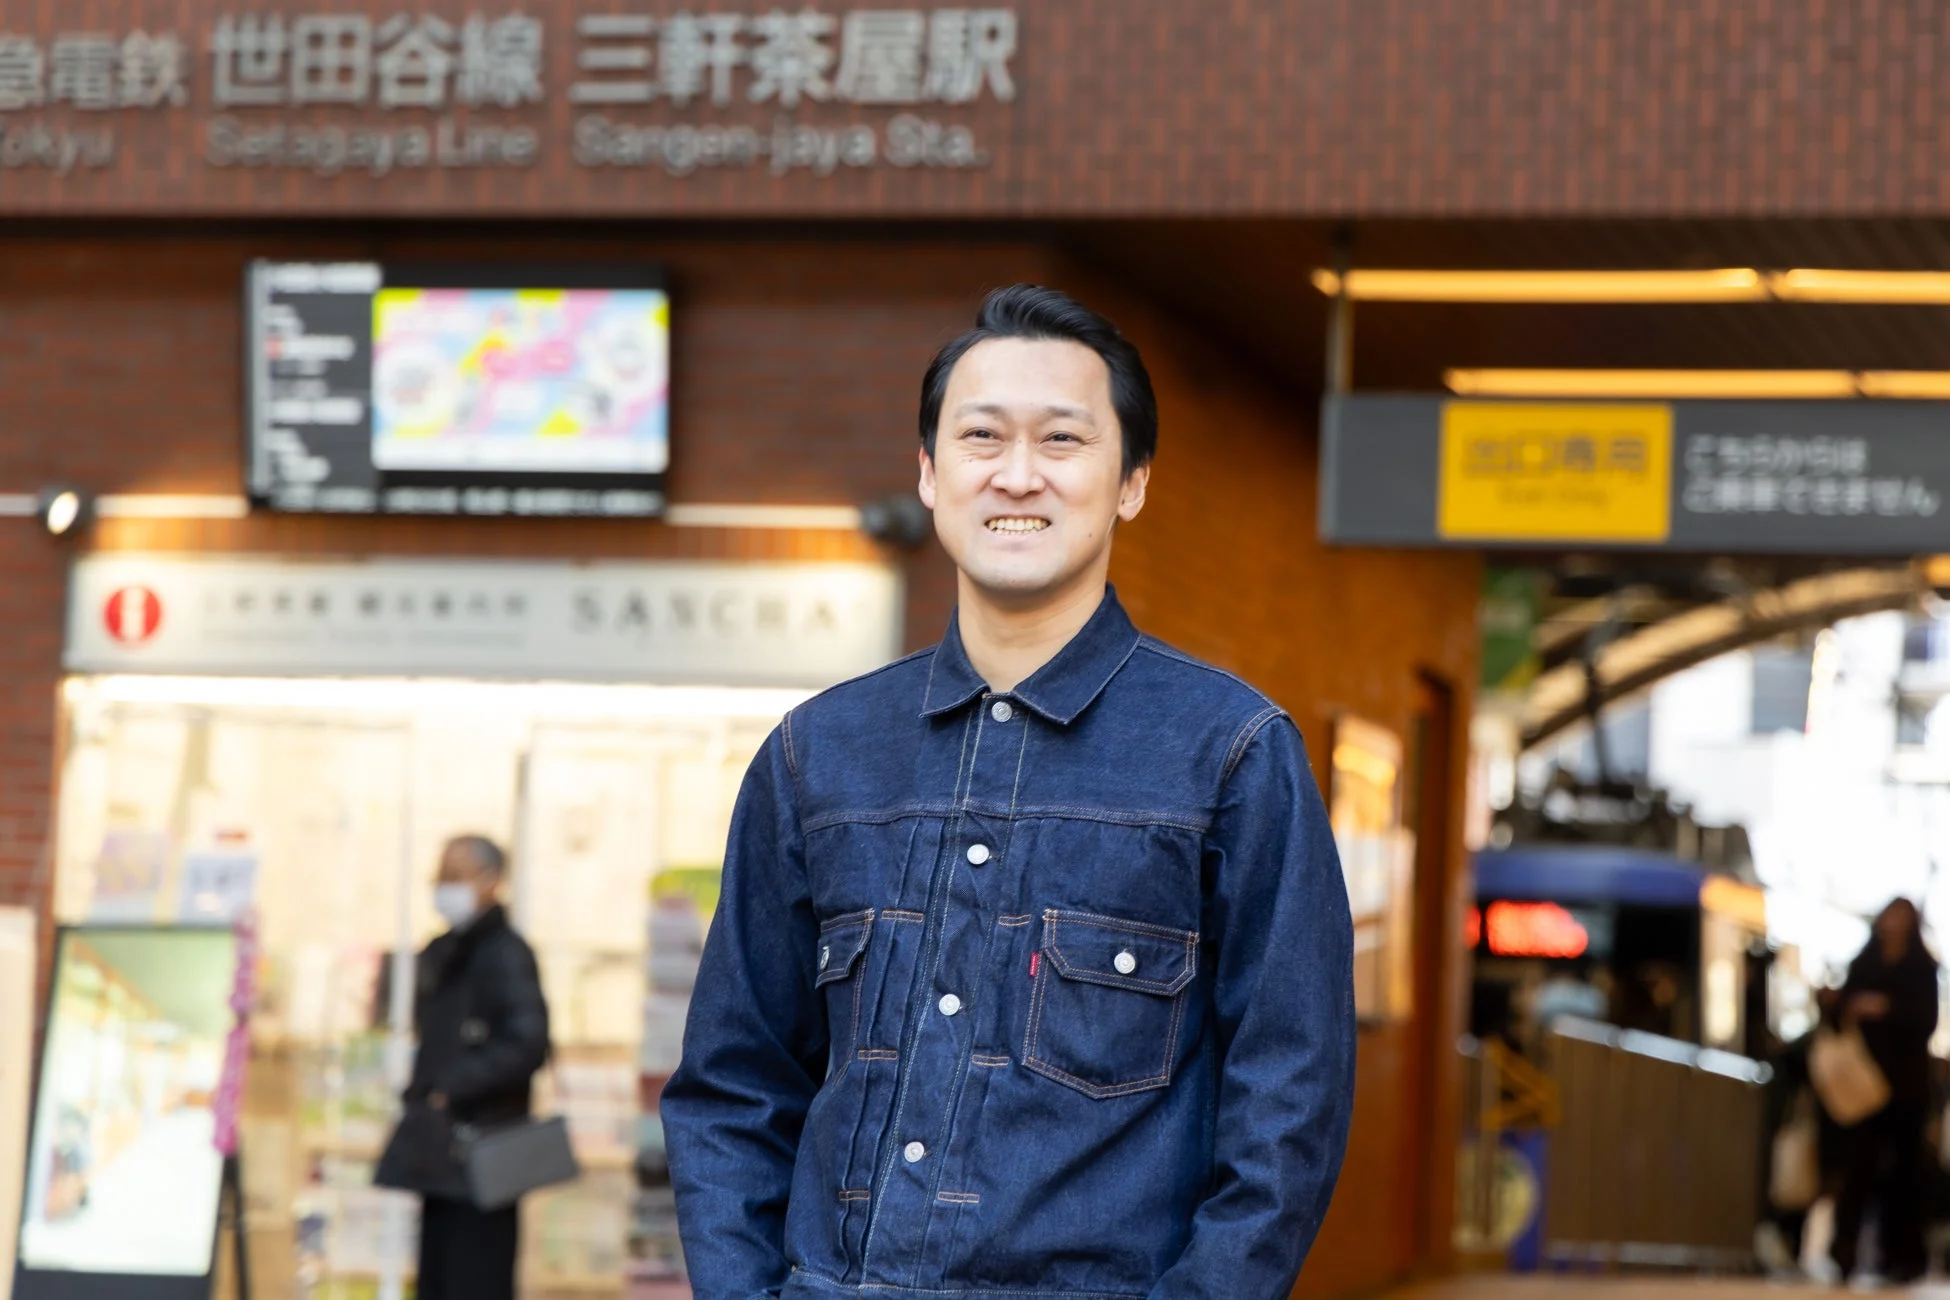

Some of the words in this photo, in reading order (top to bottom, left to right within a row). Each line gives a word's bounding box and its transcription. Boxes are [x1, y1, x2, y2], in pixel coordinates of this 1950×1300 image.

[209, 12, 543, 105] 世田谷線
[570, 10, 1017, 104] 三軒茶屋駅
[0, 117, 113, 176] okyu
[206, 115, 430, 175] Setagaya
[436, 118, 538, 168] Line
[573, 114, 876, 176] Sangen-jaya
[886, 113, 989, 167] Sta.
